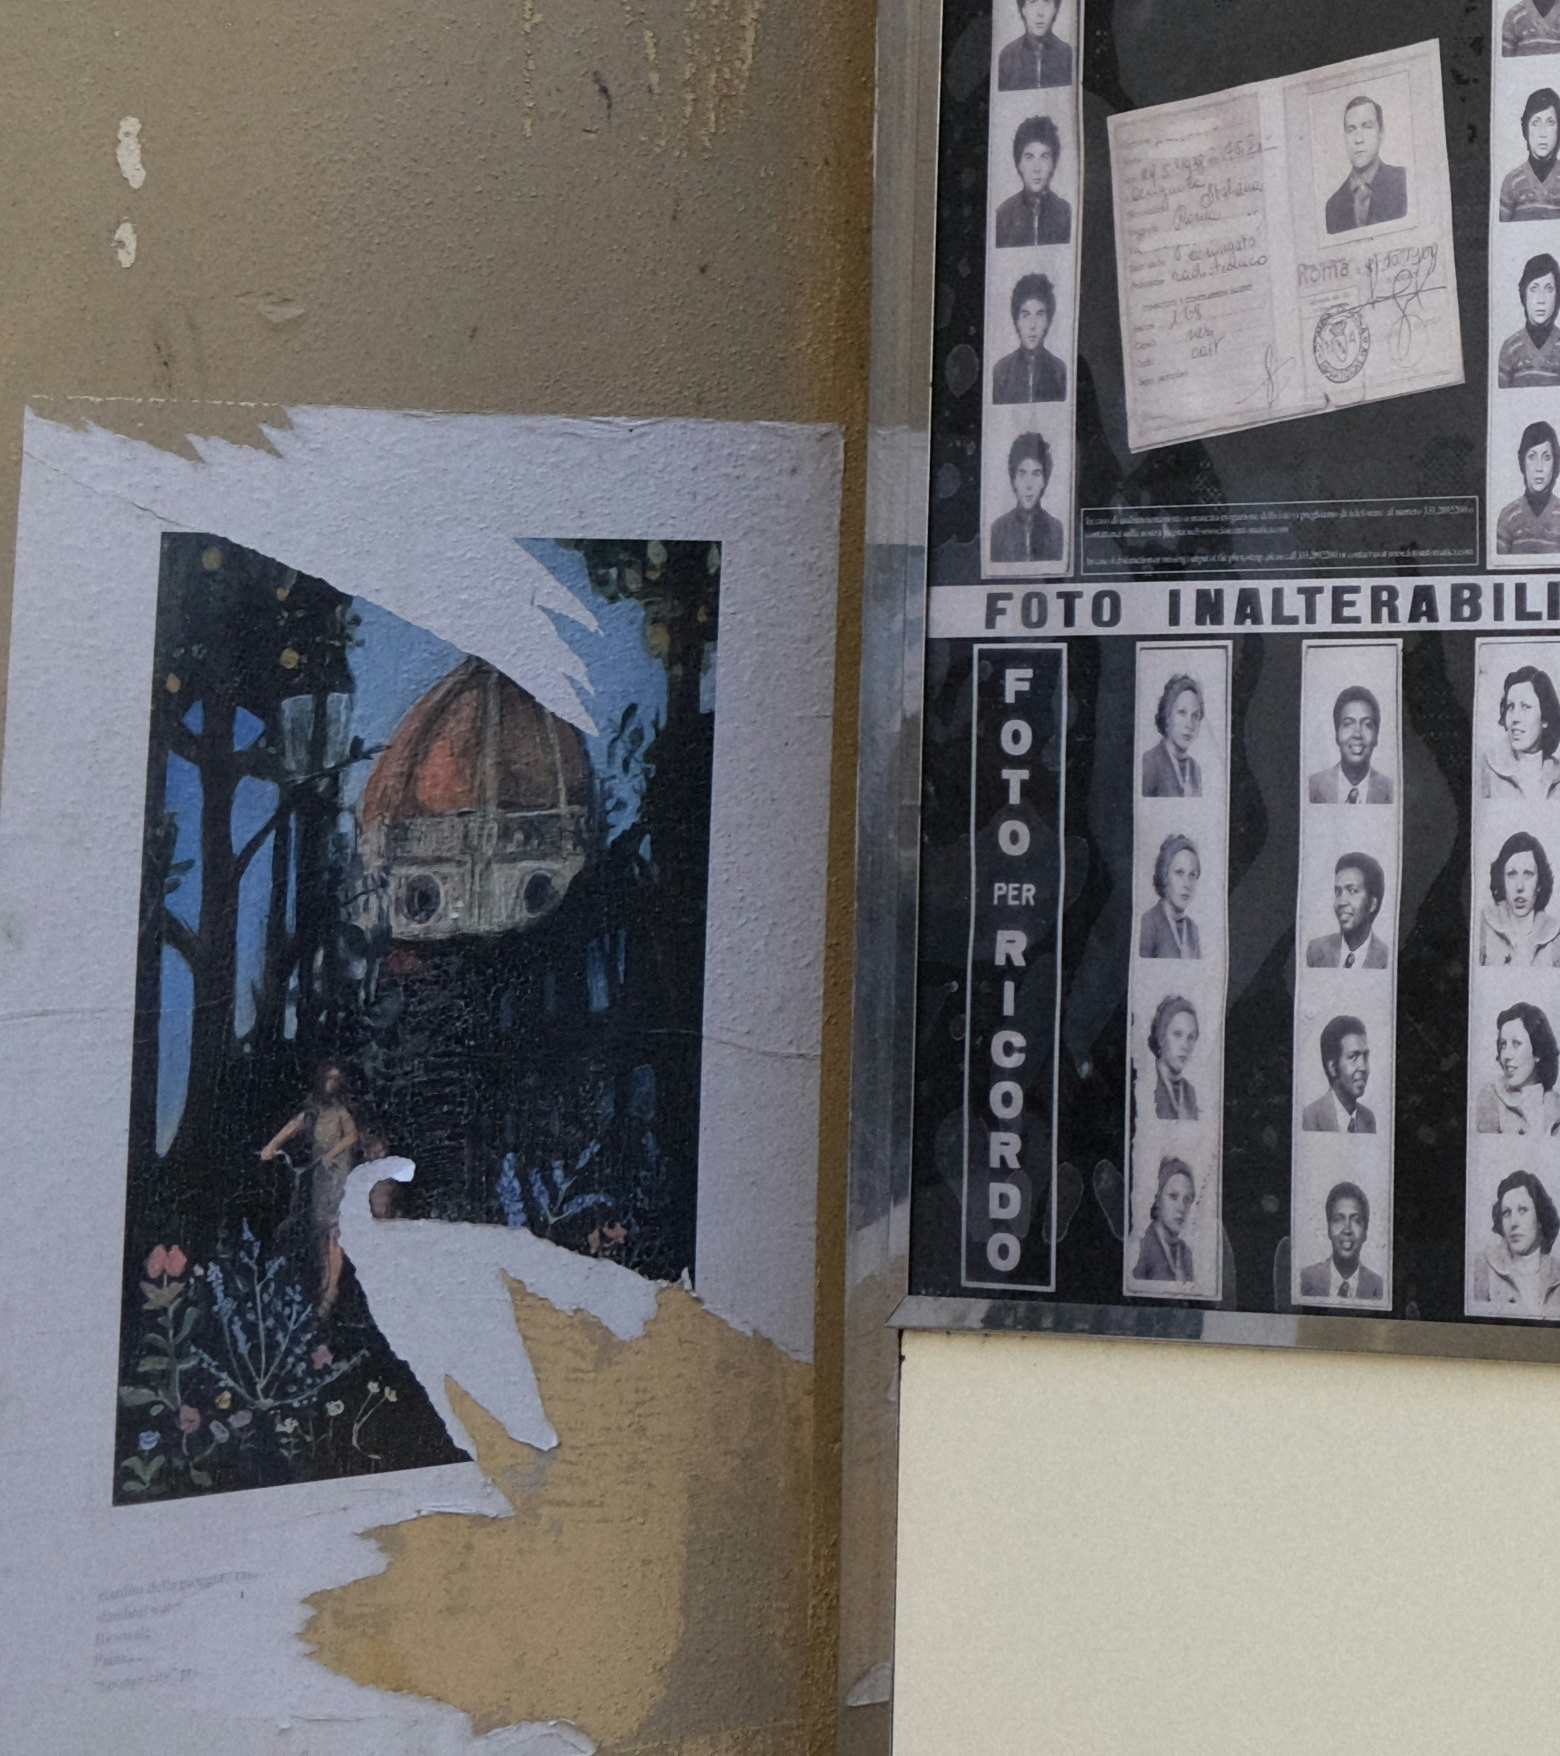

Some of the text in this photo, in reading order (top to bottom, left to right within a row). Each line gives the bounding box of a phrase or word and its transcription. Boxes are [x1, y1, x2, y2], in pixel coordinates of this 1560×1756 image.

[983, 588, 1124, 630] FOTO
[997, 667, 1034, 858] FOTO
[992, 881, 1037, 908] PER
[985, 928, 1029, 1272] RICORDO
